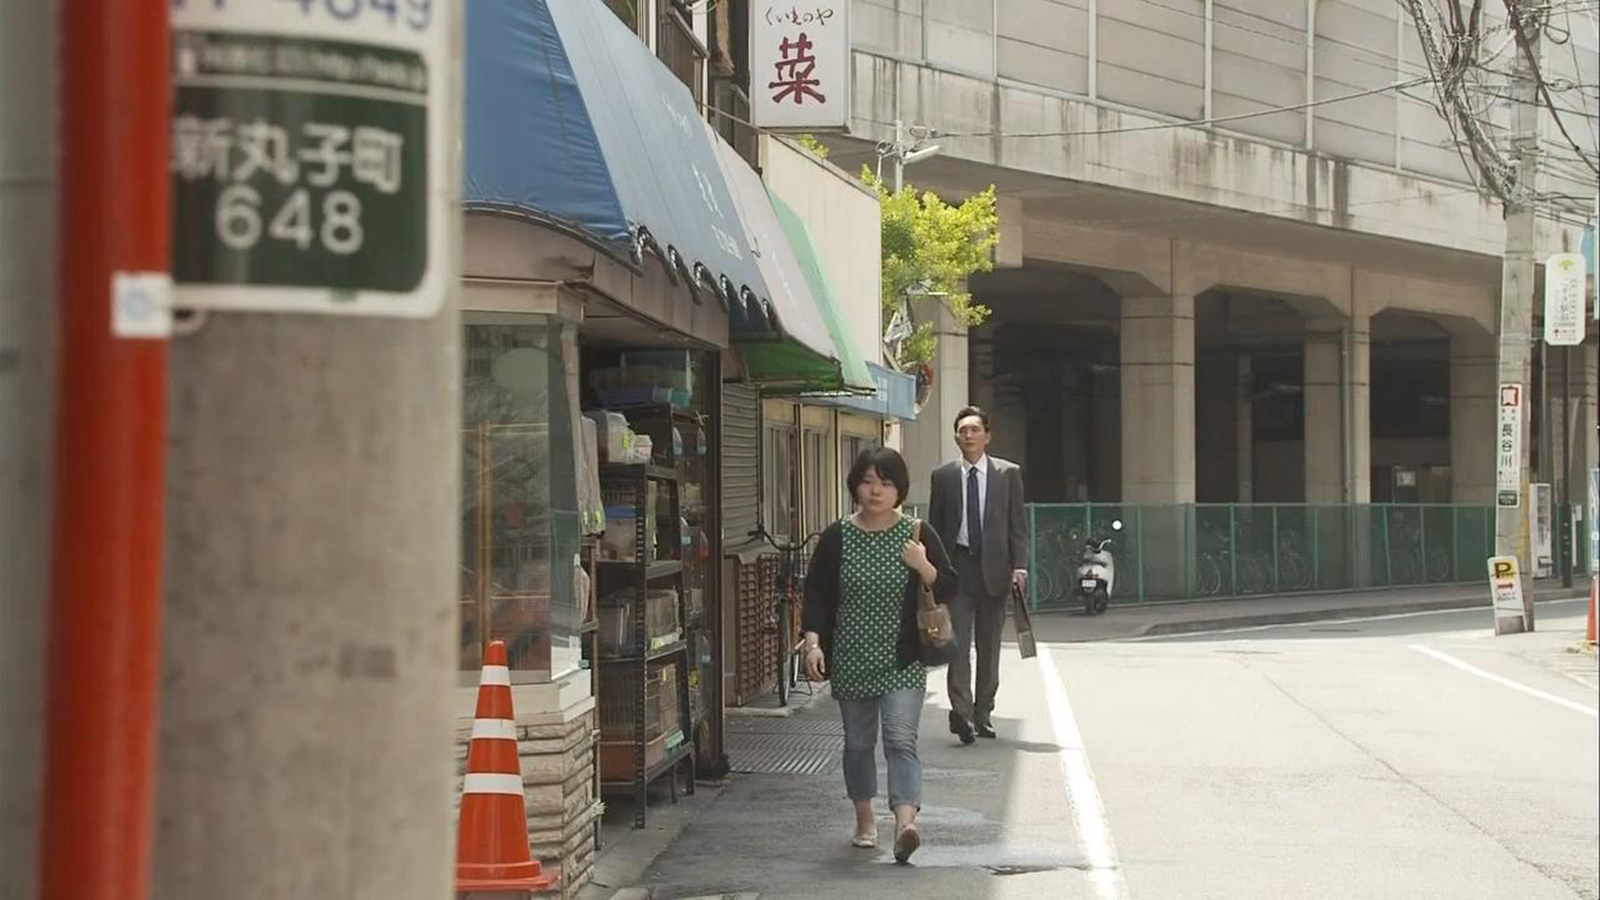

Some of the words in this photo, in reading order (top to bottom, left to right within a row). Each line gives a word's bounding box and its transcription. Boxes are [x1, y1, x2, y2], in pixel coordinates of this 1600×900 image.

[768, 32, 826, 104] 菜
[172, 115, 404, 194] 新丸子町
[215, 183, 364, 255] 648
[1501, 423, 1513, 468] 長谷川
[1494, 562, 1511, 579] P
